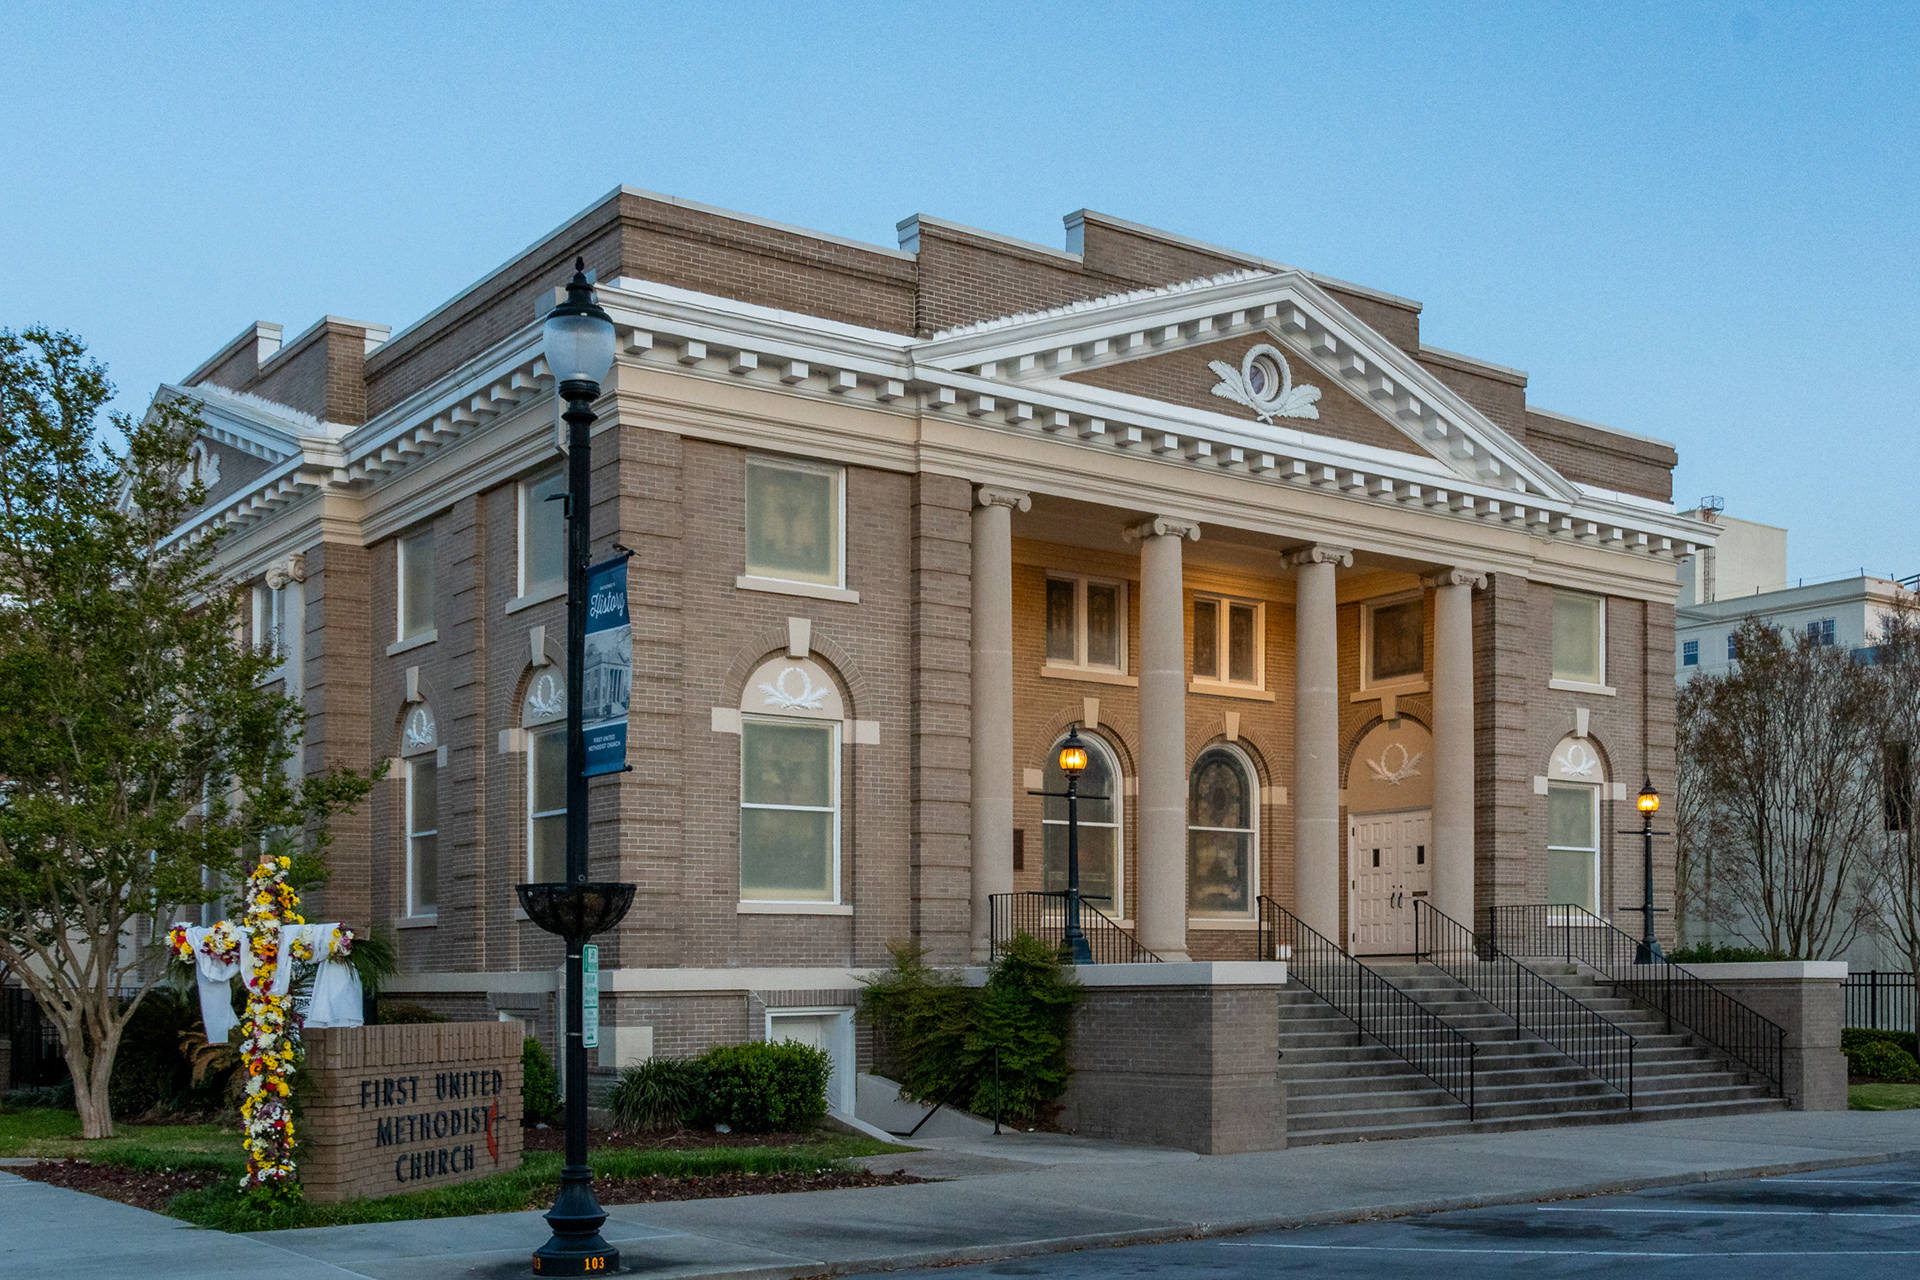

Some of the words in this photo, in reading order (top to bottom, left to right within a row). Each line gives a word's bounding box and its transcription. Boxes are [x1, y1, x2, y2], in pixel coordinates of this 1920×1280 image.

[590, 591, 625, 619] History
[361, 1076, 419, 1109] FIRST
[436, 1070, 502, 1100] UNITED
[376, 1106, 491, 1147] METHODIST
[396, 1144, 474, 1183] CHURCH
[584, 1256, 605, 1271] 103
